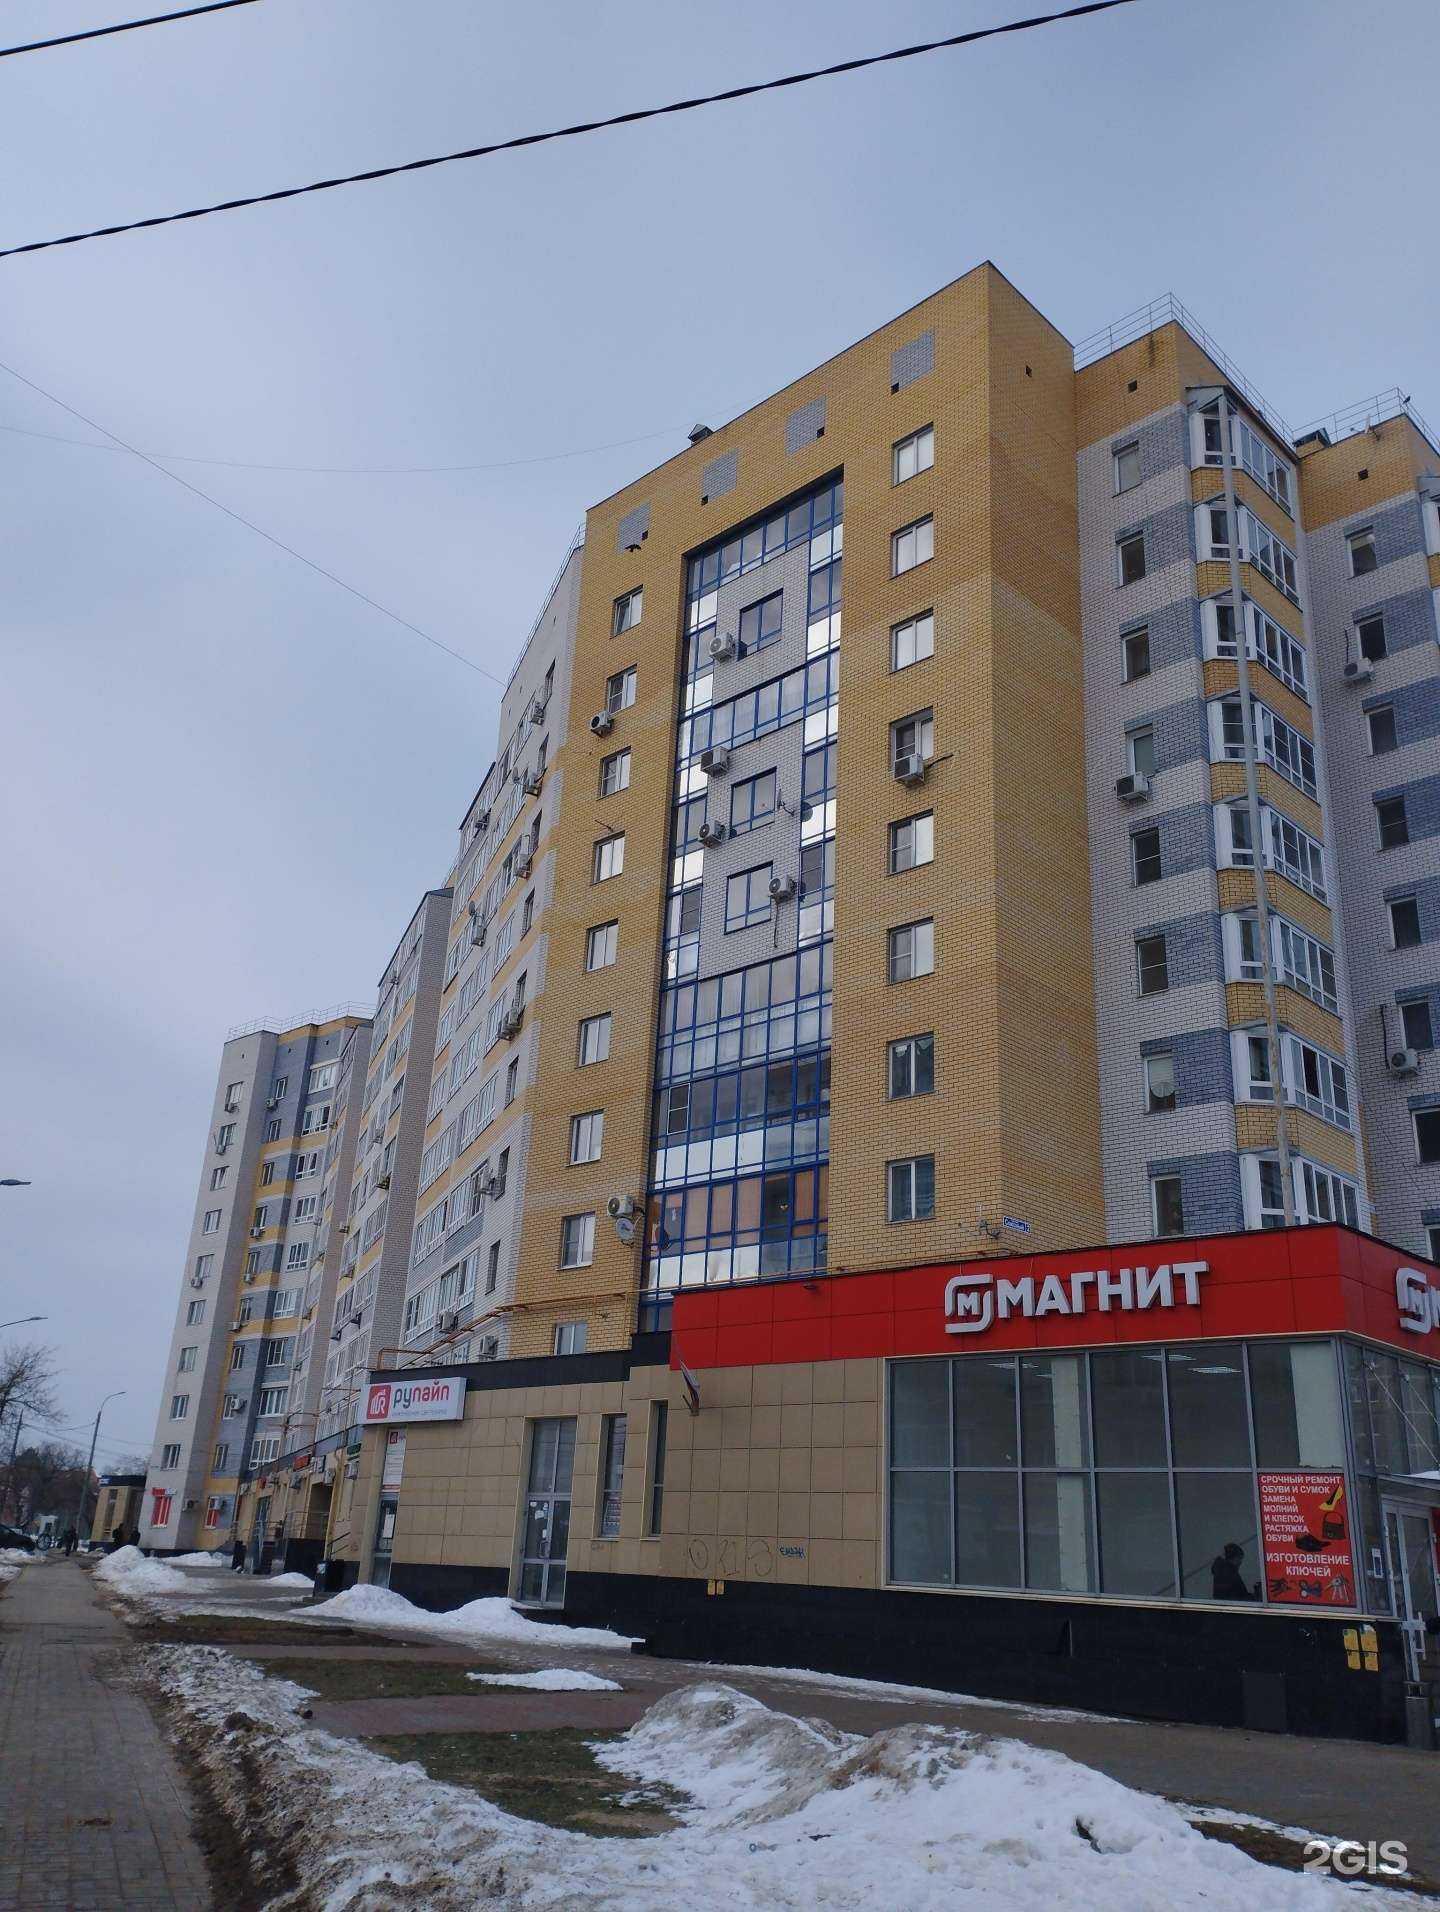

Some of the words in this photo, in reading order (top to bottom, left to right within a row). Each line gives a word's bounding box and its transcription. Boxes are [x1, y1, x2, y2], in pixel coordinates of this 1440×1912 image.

[997, 1261, 1209, 1318] МАГНИТ
[393, 1381, 449, 1409] рупайп
[1261, 1475, 1304, 1484] СРОЧНЫЙ
[1305, 1476, 1341, 1484] РЕМОНТ
[1262, 1485, 1291, 1493] ОБУВИ
[1292, 1486, 1299, 1494] И
[1300, 1486, 1330, 1494] СУМОК
[1262, 1495, 1296, 1503] ЗАМЕНА
[1263, 1504, 1299, 1513] МОЛНИЙ
[1271, 1515, 1305, 1523] КЛЕПОК
[1265, 1525, 1309, 1533] РАСТЯЖКА
[1266, 1534, 1294, 1542] ОБУВИ
[1266, 1553, 1350, 1565] ИЗГОТОВЛЕНИЕ
[1286, 1566, 1331, 1577] КЛЮЧЕЙ
